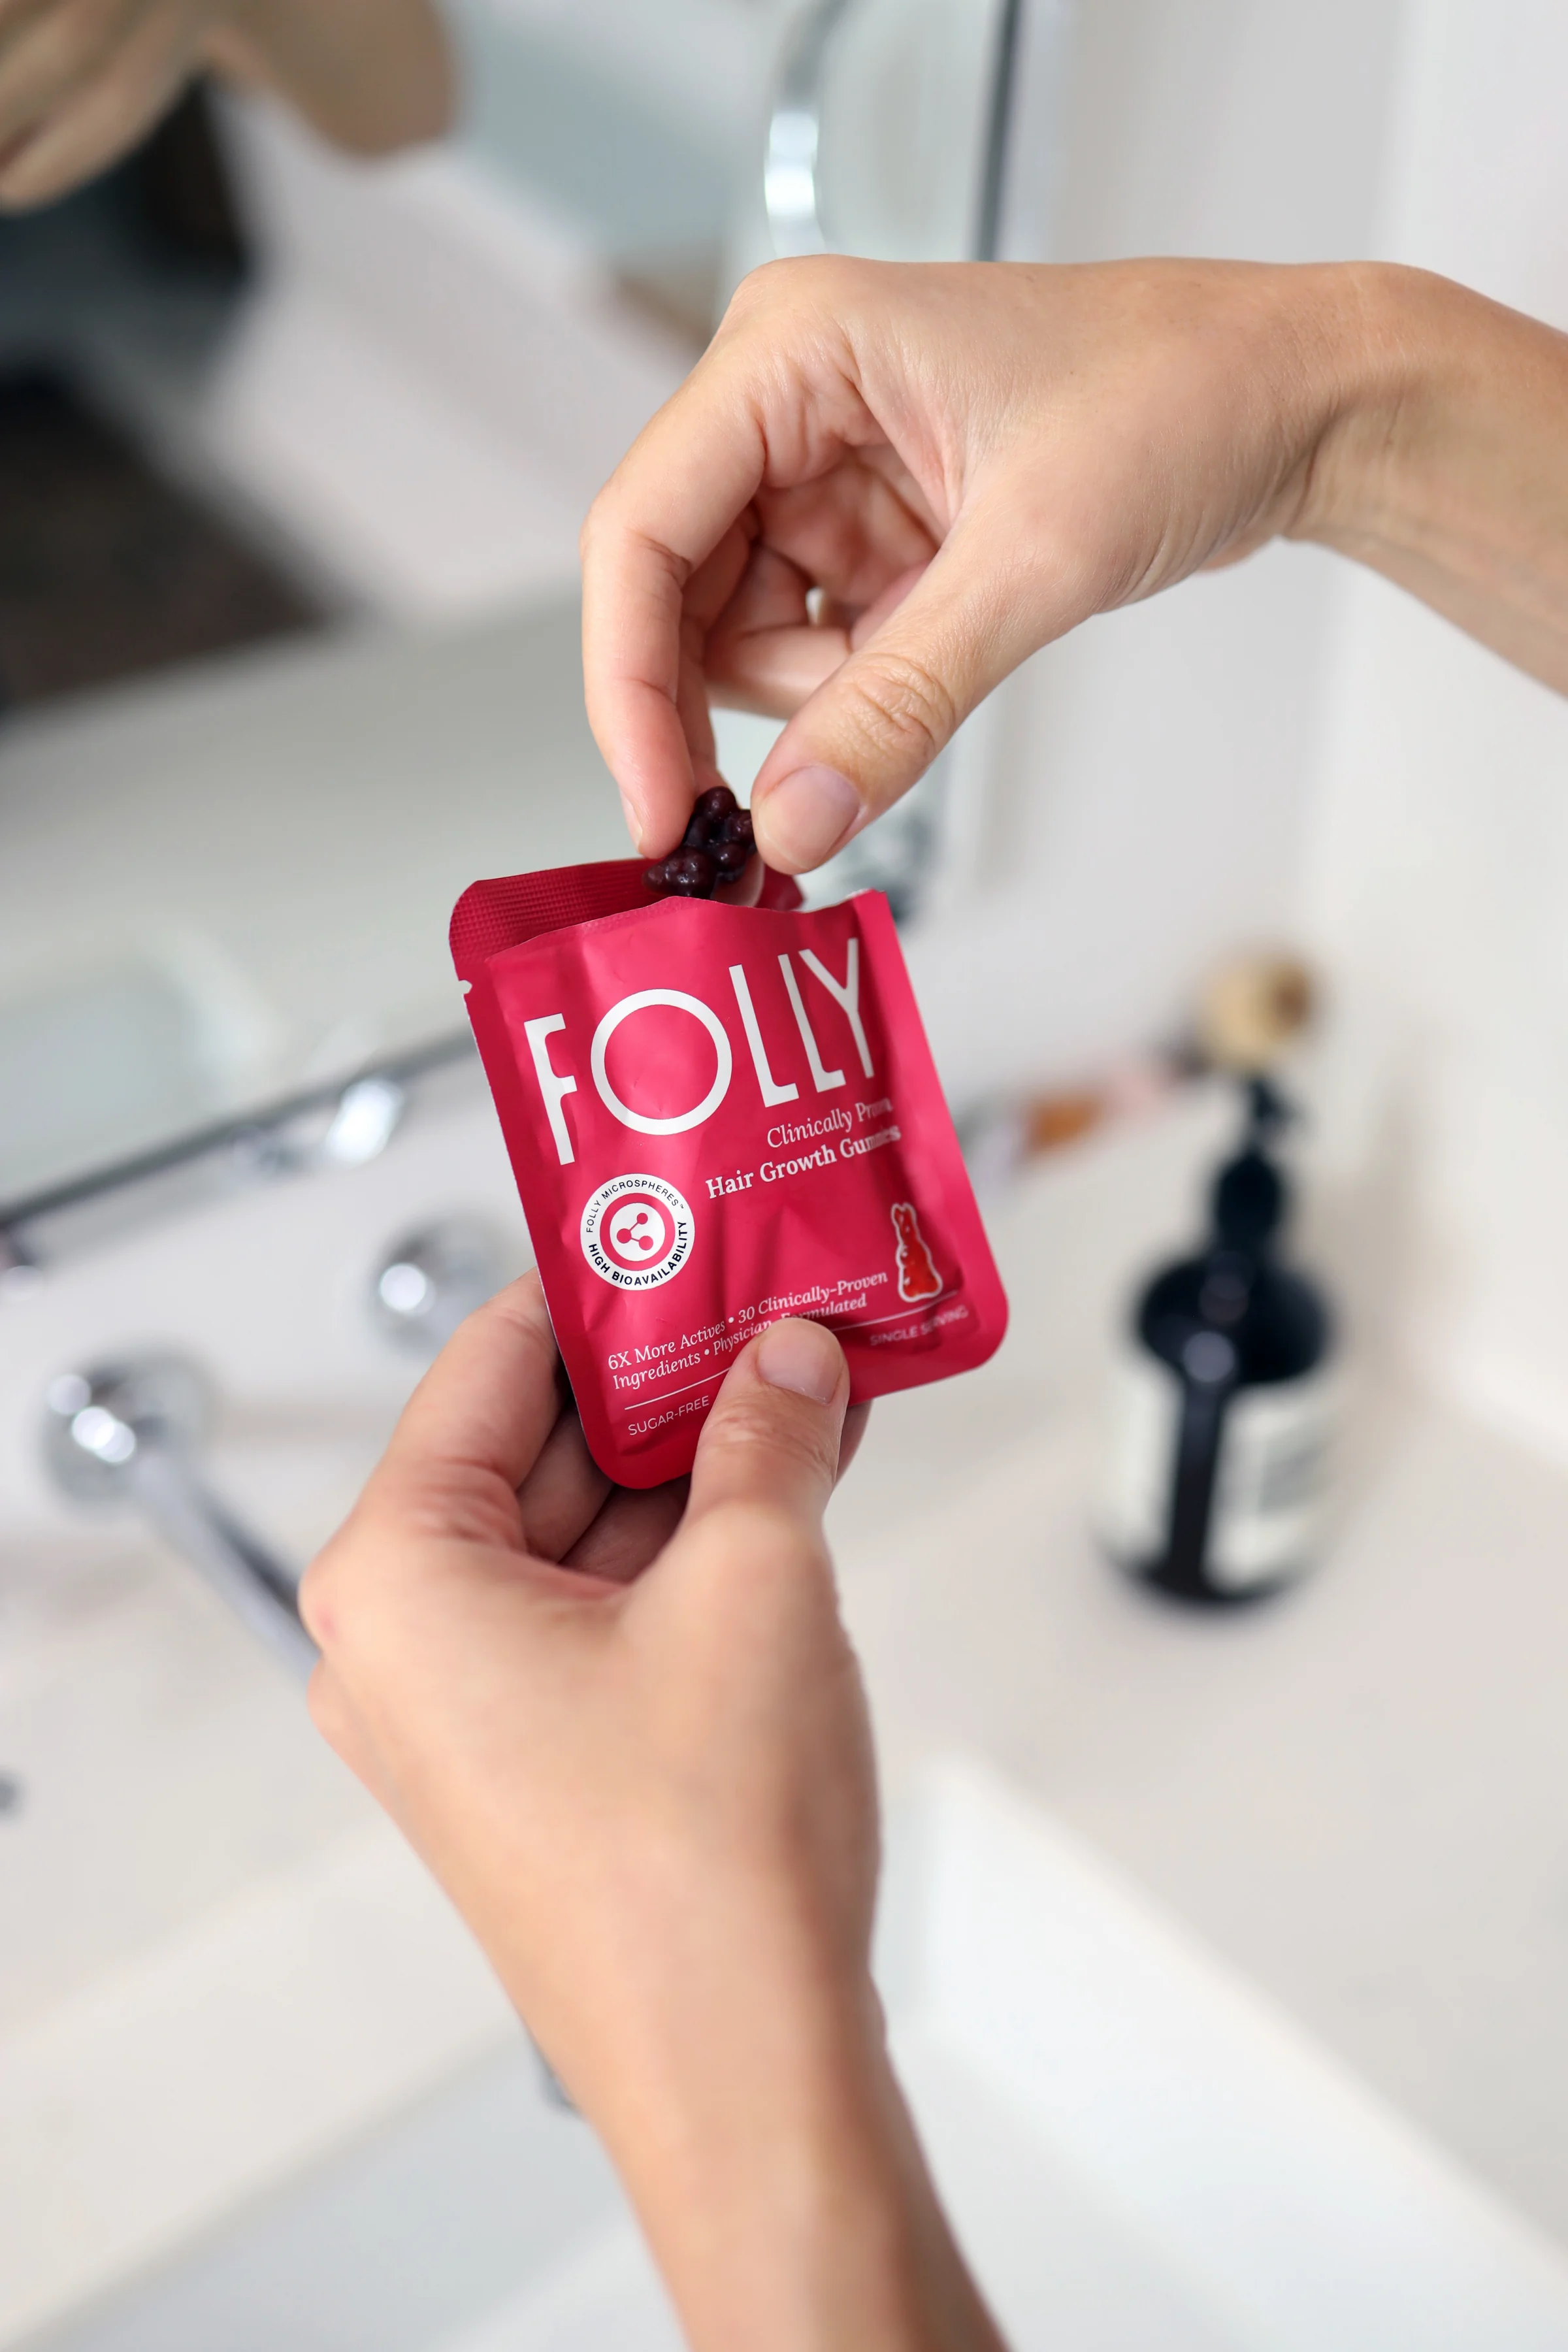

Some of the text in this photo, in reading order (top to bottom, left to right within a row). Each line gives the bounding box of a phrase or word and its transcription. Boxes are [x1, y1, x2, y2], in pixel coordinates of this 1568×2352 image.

[524, 938, 874, 1166] FOLLY
[767, 1097, 894, 1148] Clinically Prn
[706, 1124, 902, 1199] Hair Growth Gumes
[586, 1200, 601, 1233] FOLLY
[589, 1221, 688, 1286] HIGH BIOAVAILABILITY
[608, 1271, 888, 1370] 6X More Actives 30 Clinically-Proven
[870, 1324, 918, 1346] SINGLE
[613, 1352, 700, 1390] Ingredients
[628, 1395, 710, 1435] SUGAR-FREE
